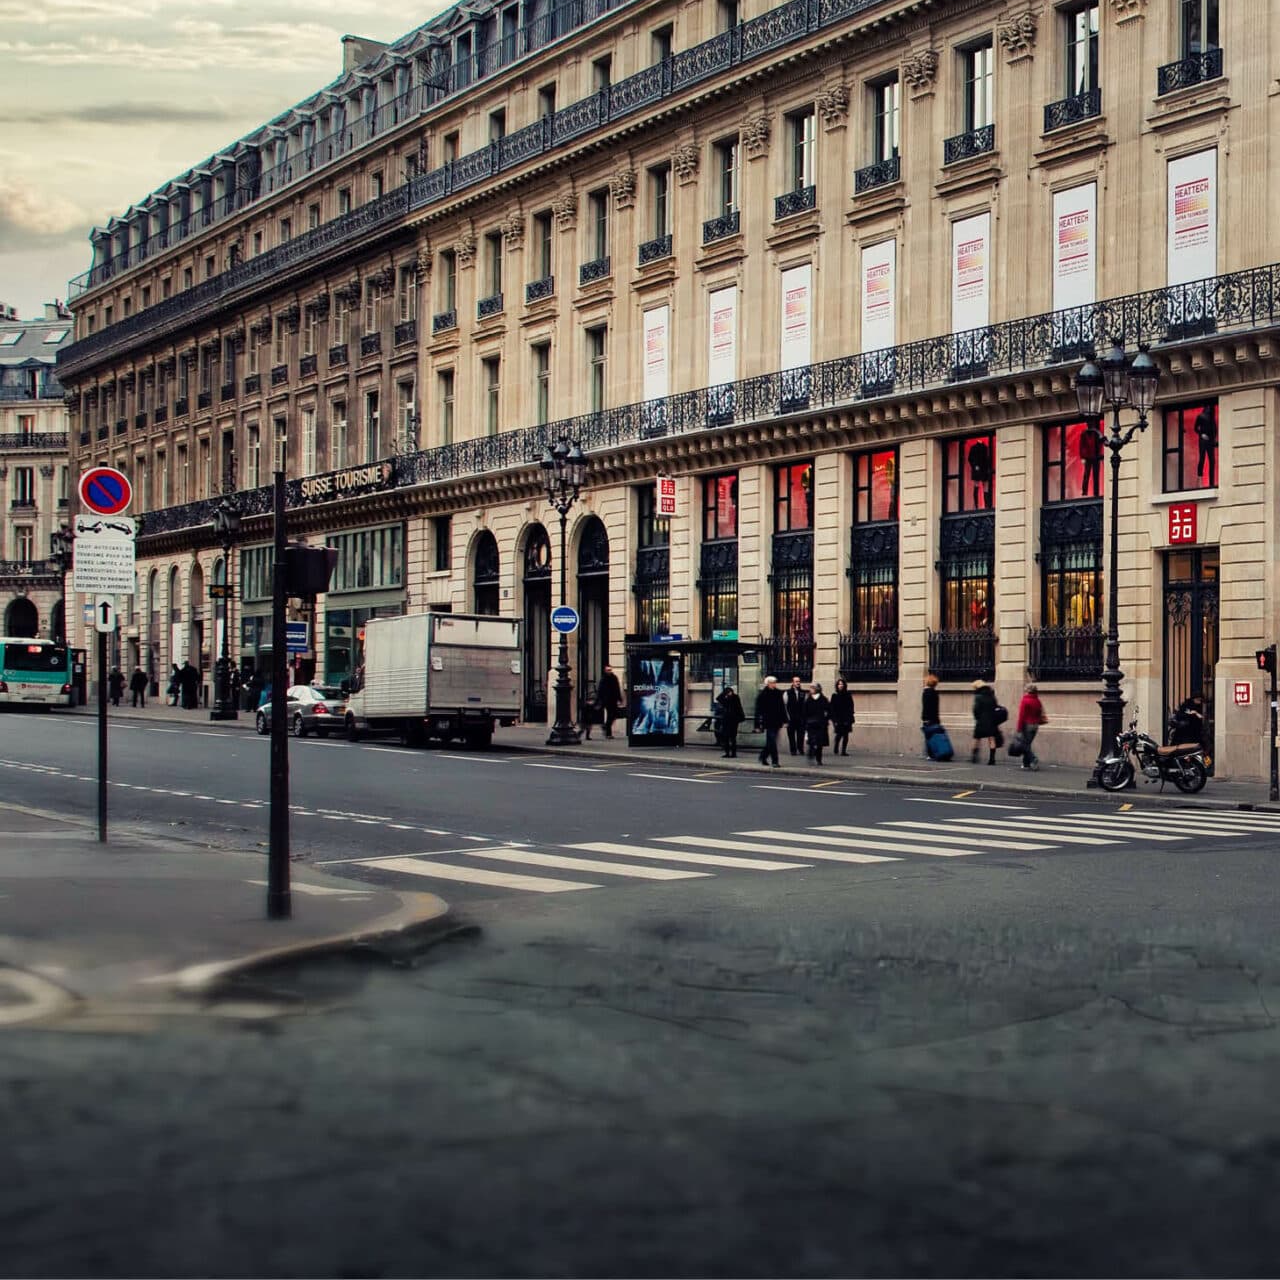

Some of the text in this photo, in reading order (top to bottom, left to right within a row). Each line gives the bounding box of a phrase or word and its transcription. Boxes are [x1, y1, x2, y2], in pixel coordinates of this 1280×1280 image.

[1175, 182, 1209, 199] HEATTECH
[1059, 214, 1089, 229] HEATTECH
[301, 466, 382, 498] SUISSE TOURISME
